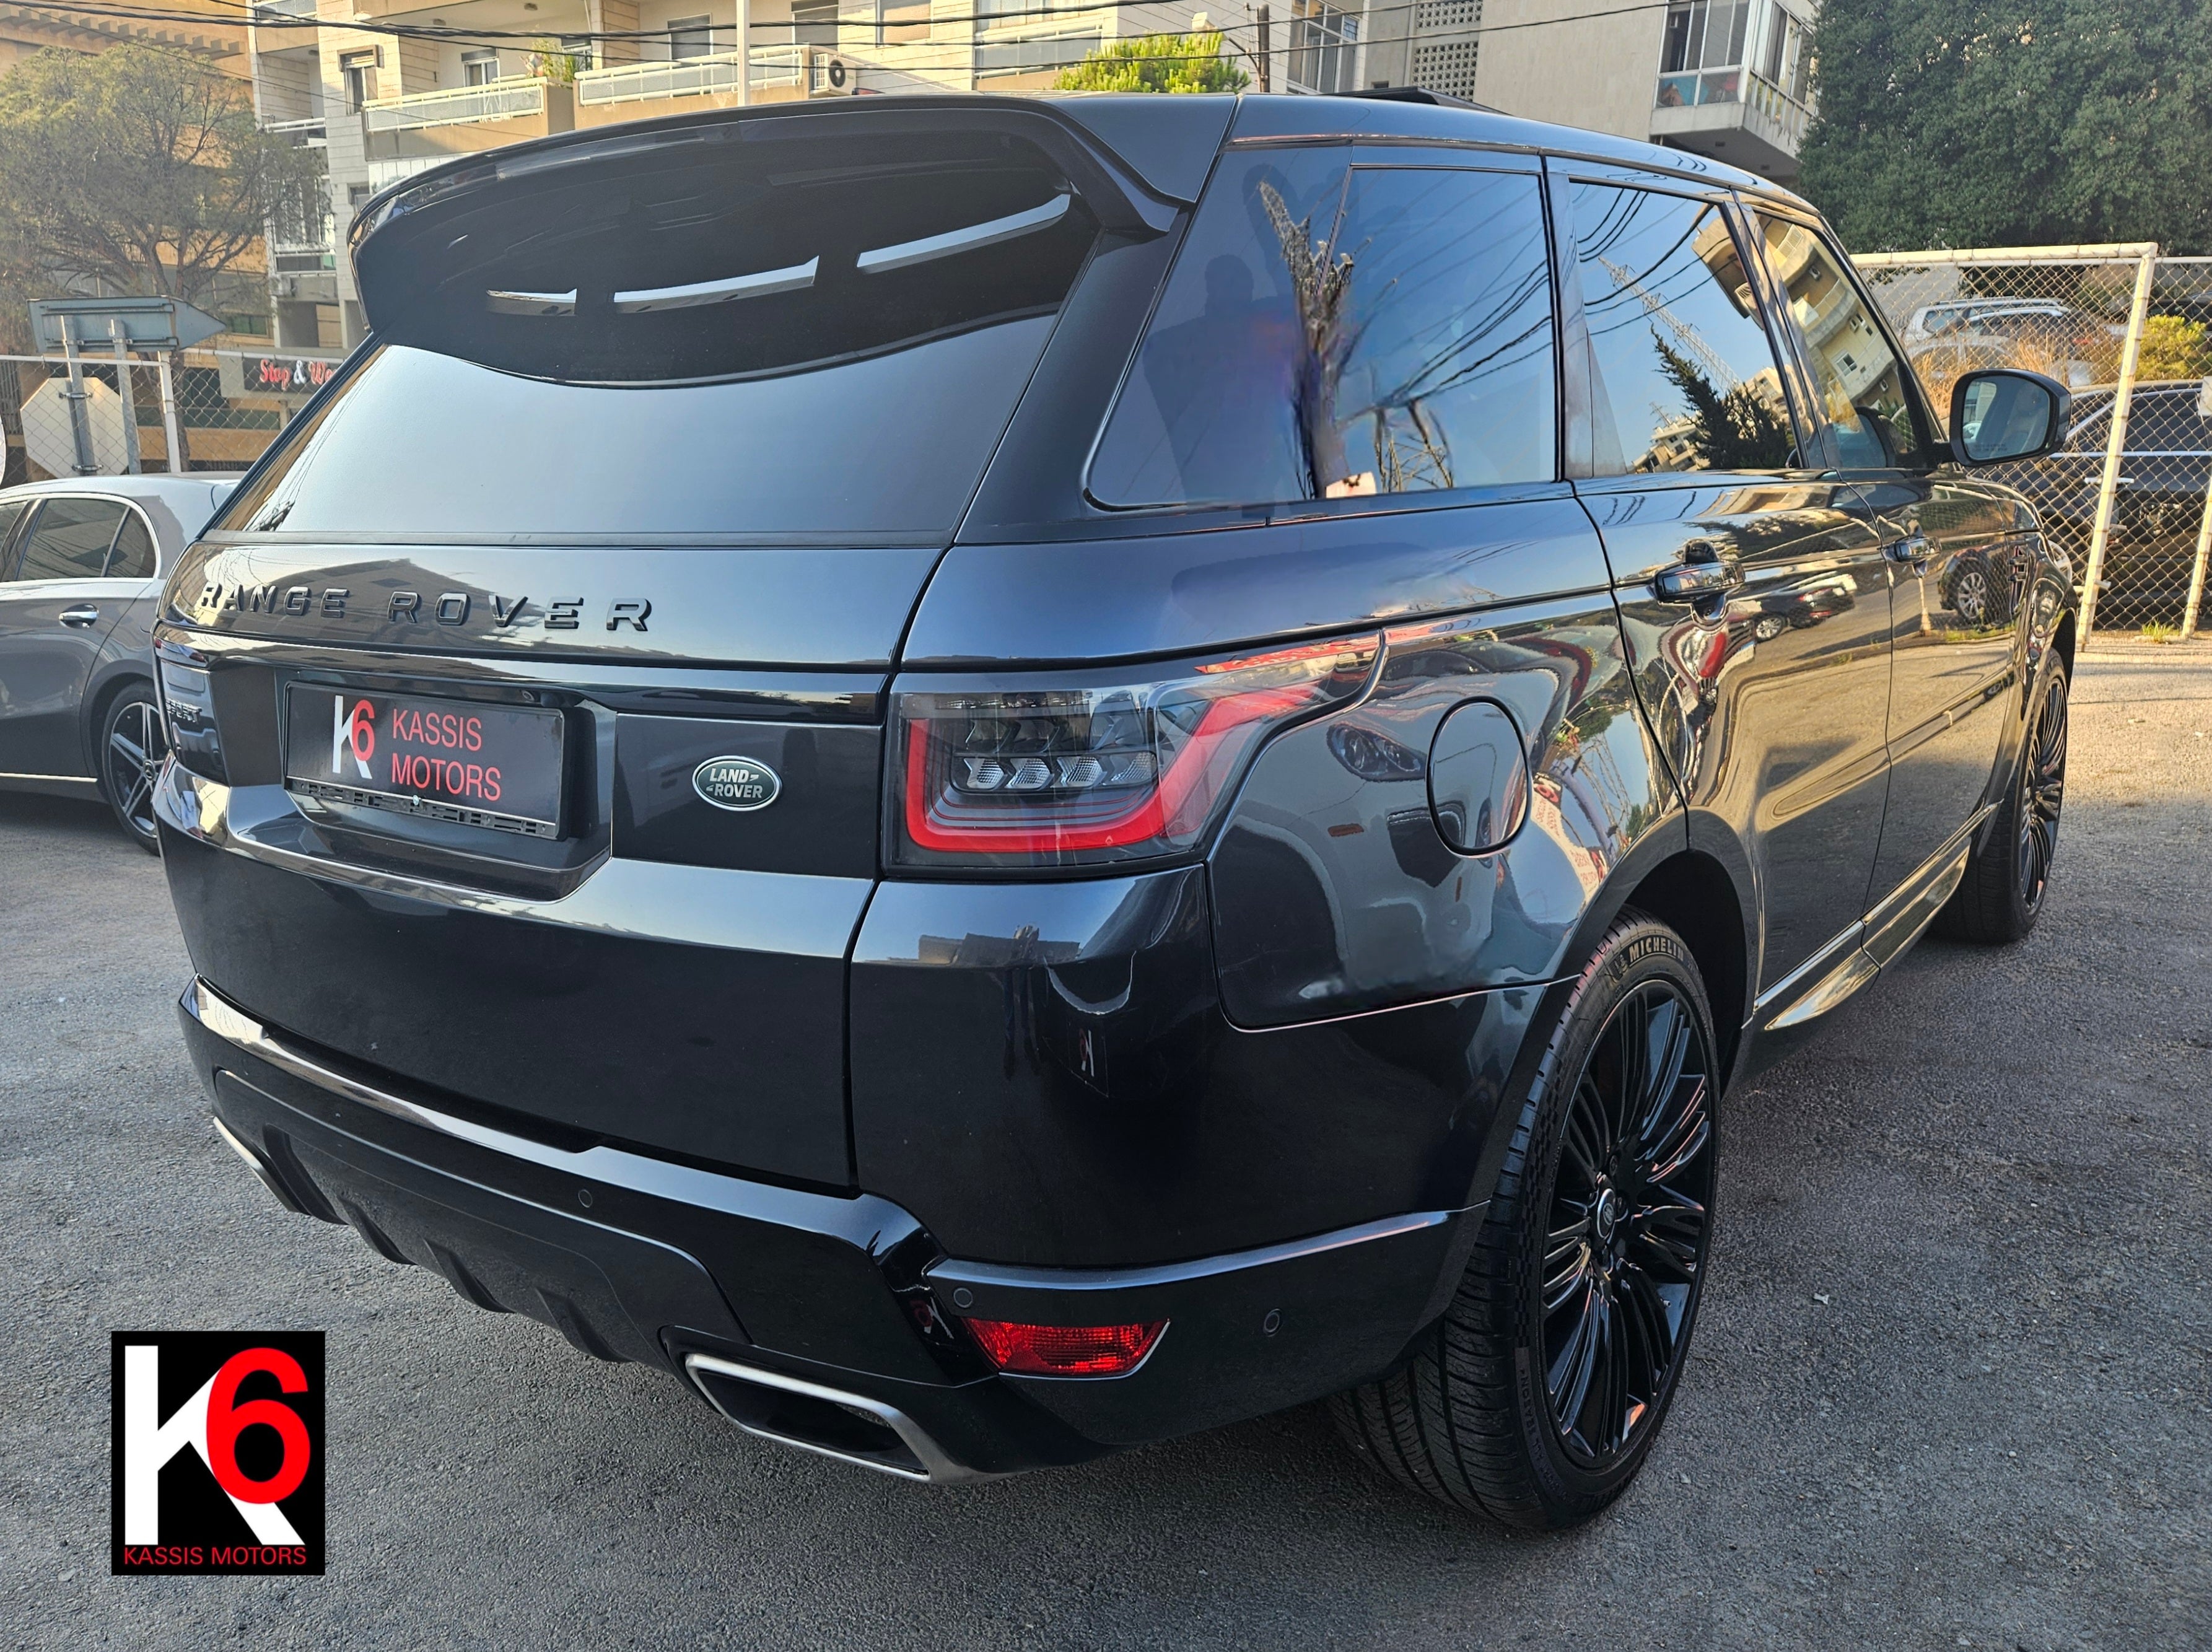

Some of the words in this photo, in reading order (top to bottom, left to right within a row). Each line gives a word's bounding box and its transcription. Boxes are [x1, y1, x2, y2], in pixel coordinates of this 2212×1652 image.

[294, 359, 307, 385] &
[199, 581, 350, 619] RANGE
[387, 591, 652, 632] ROVER
[392, 708, 482, 751] KASSIS
[391, 753, 501, 801] MOTORS
[709, 767, 750, 783] LAND
[714, 783, 763, 798] ROVER
[1628, 937, 1684, 963] MICHELIN
